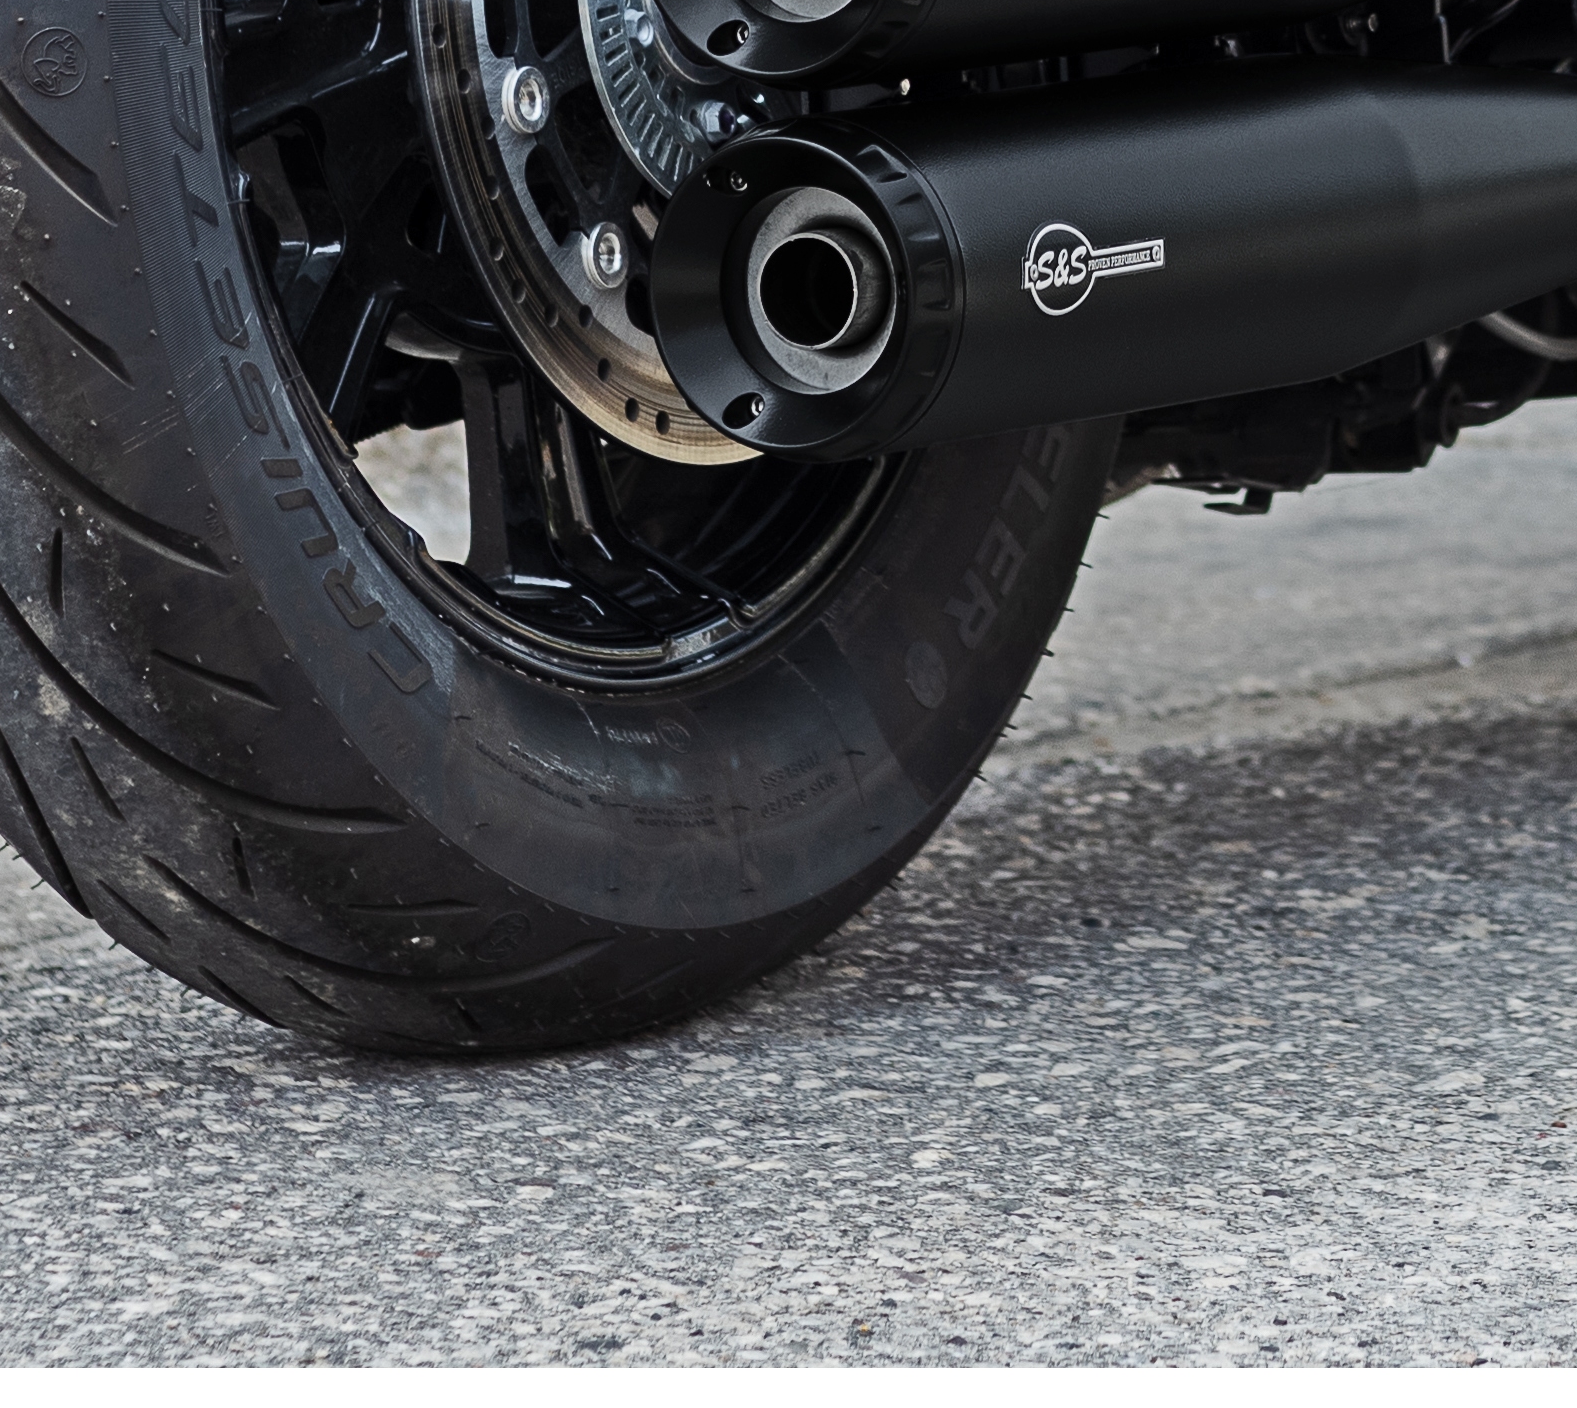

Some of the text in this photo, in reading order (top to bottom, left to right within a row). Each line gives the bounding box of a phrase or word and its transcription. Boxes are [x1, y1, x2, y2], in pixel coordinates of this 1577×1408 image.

[1034, 245, 1151, 291] S&S PROVEN PERFORMANCE
